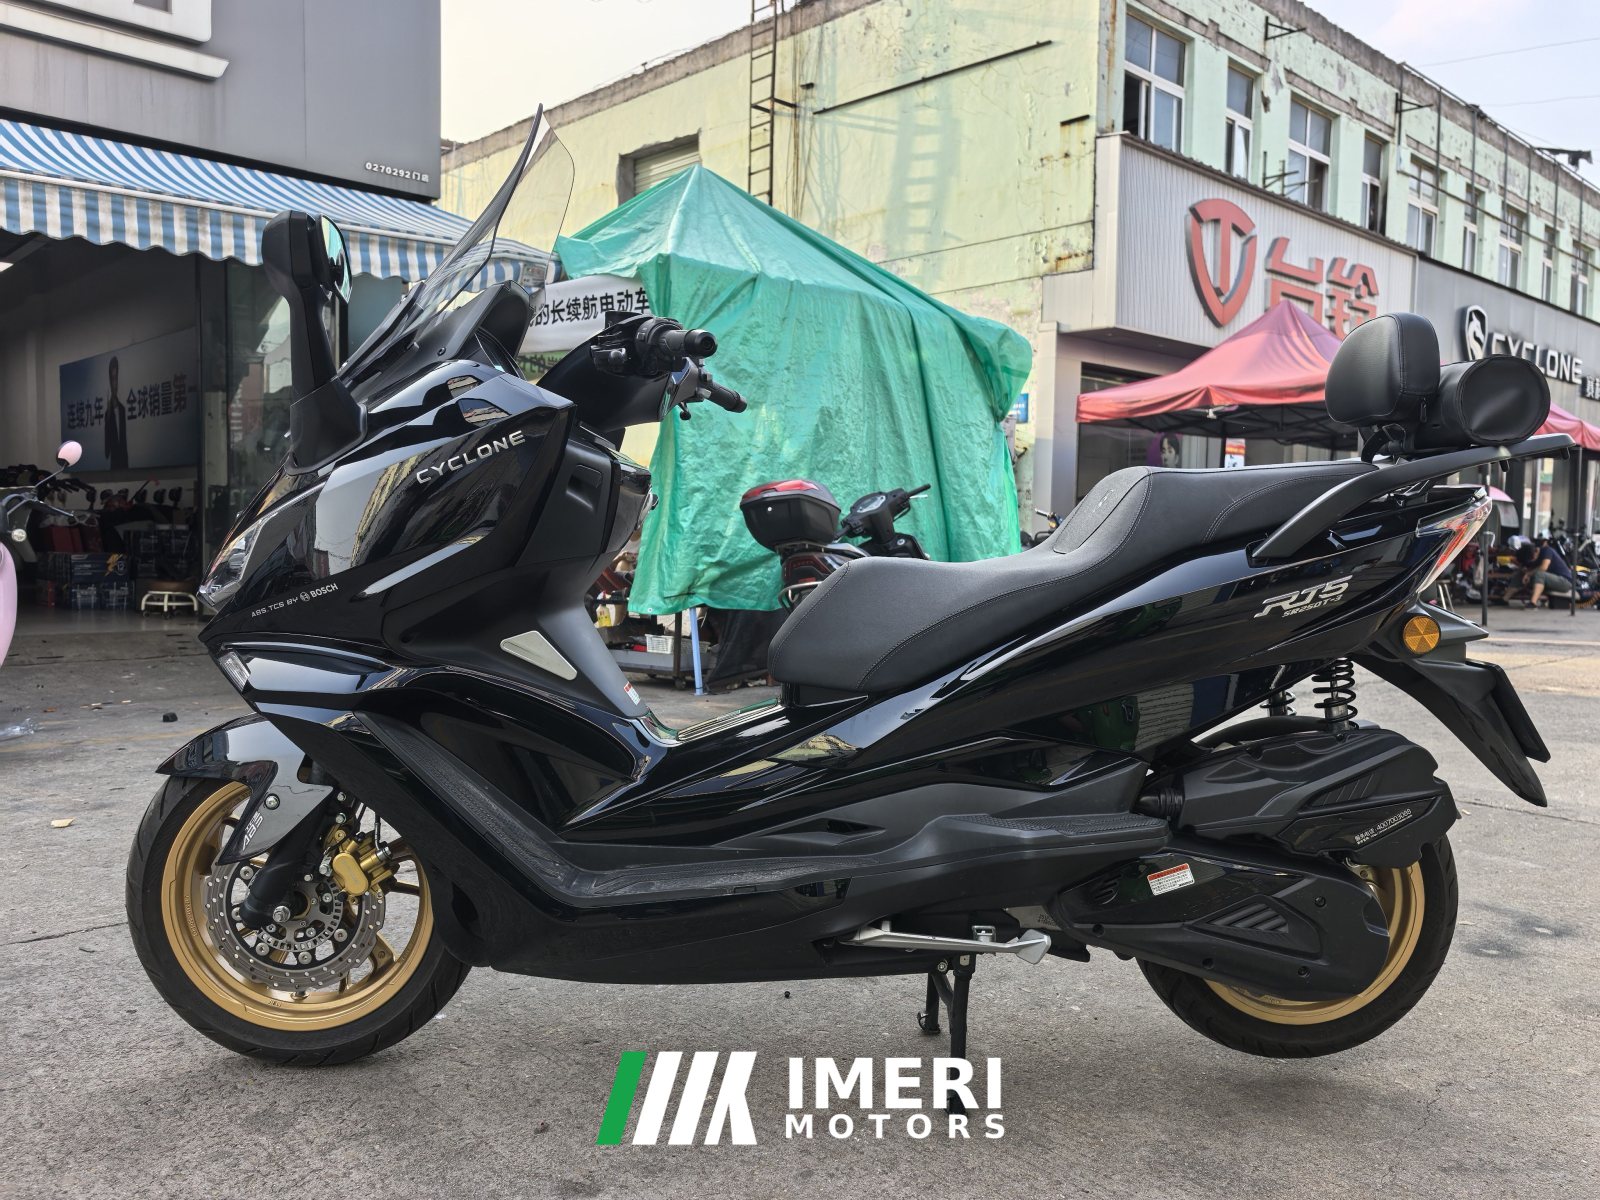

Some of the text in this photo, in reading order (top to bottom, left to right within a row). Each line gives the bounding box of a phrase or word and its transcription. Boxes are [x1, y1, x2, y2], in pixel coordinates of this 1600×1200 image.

[530, 287, 650, 327] 的长续航电动车
[1491, 332, 1583, 385] CYCLONE
[67, 396, 104, 429] 连续九年
[416, 430, 526, 484] CYCLONE
[309, 583, 339, 598] BOSCH
